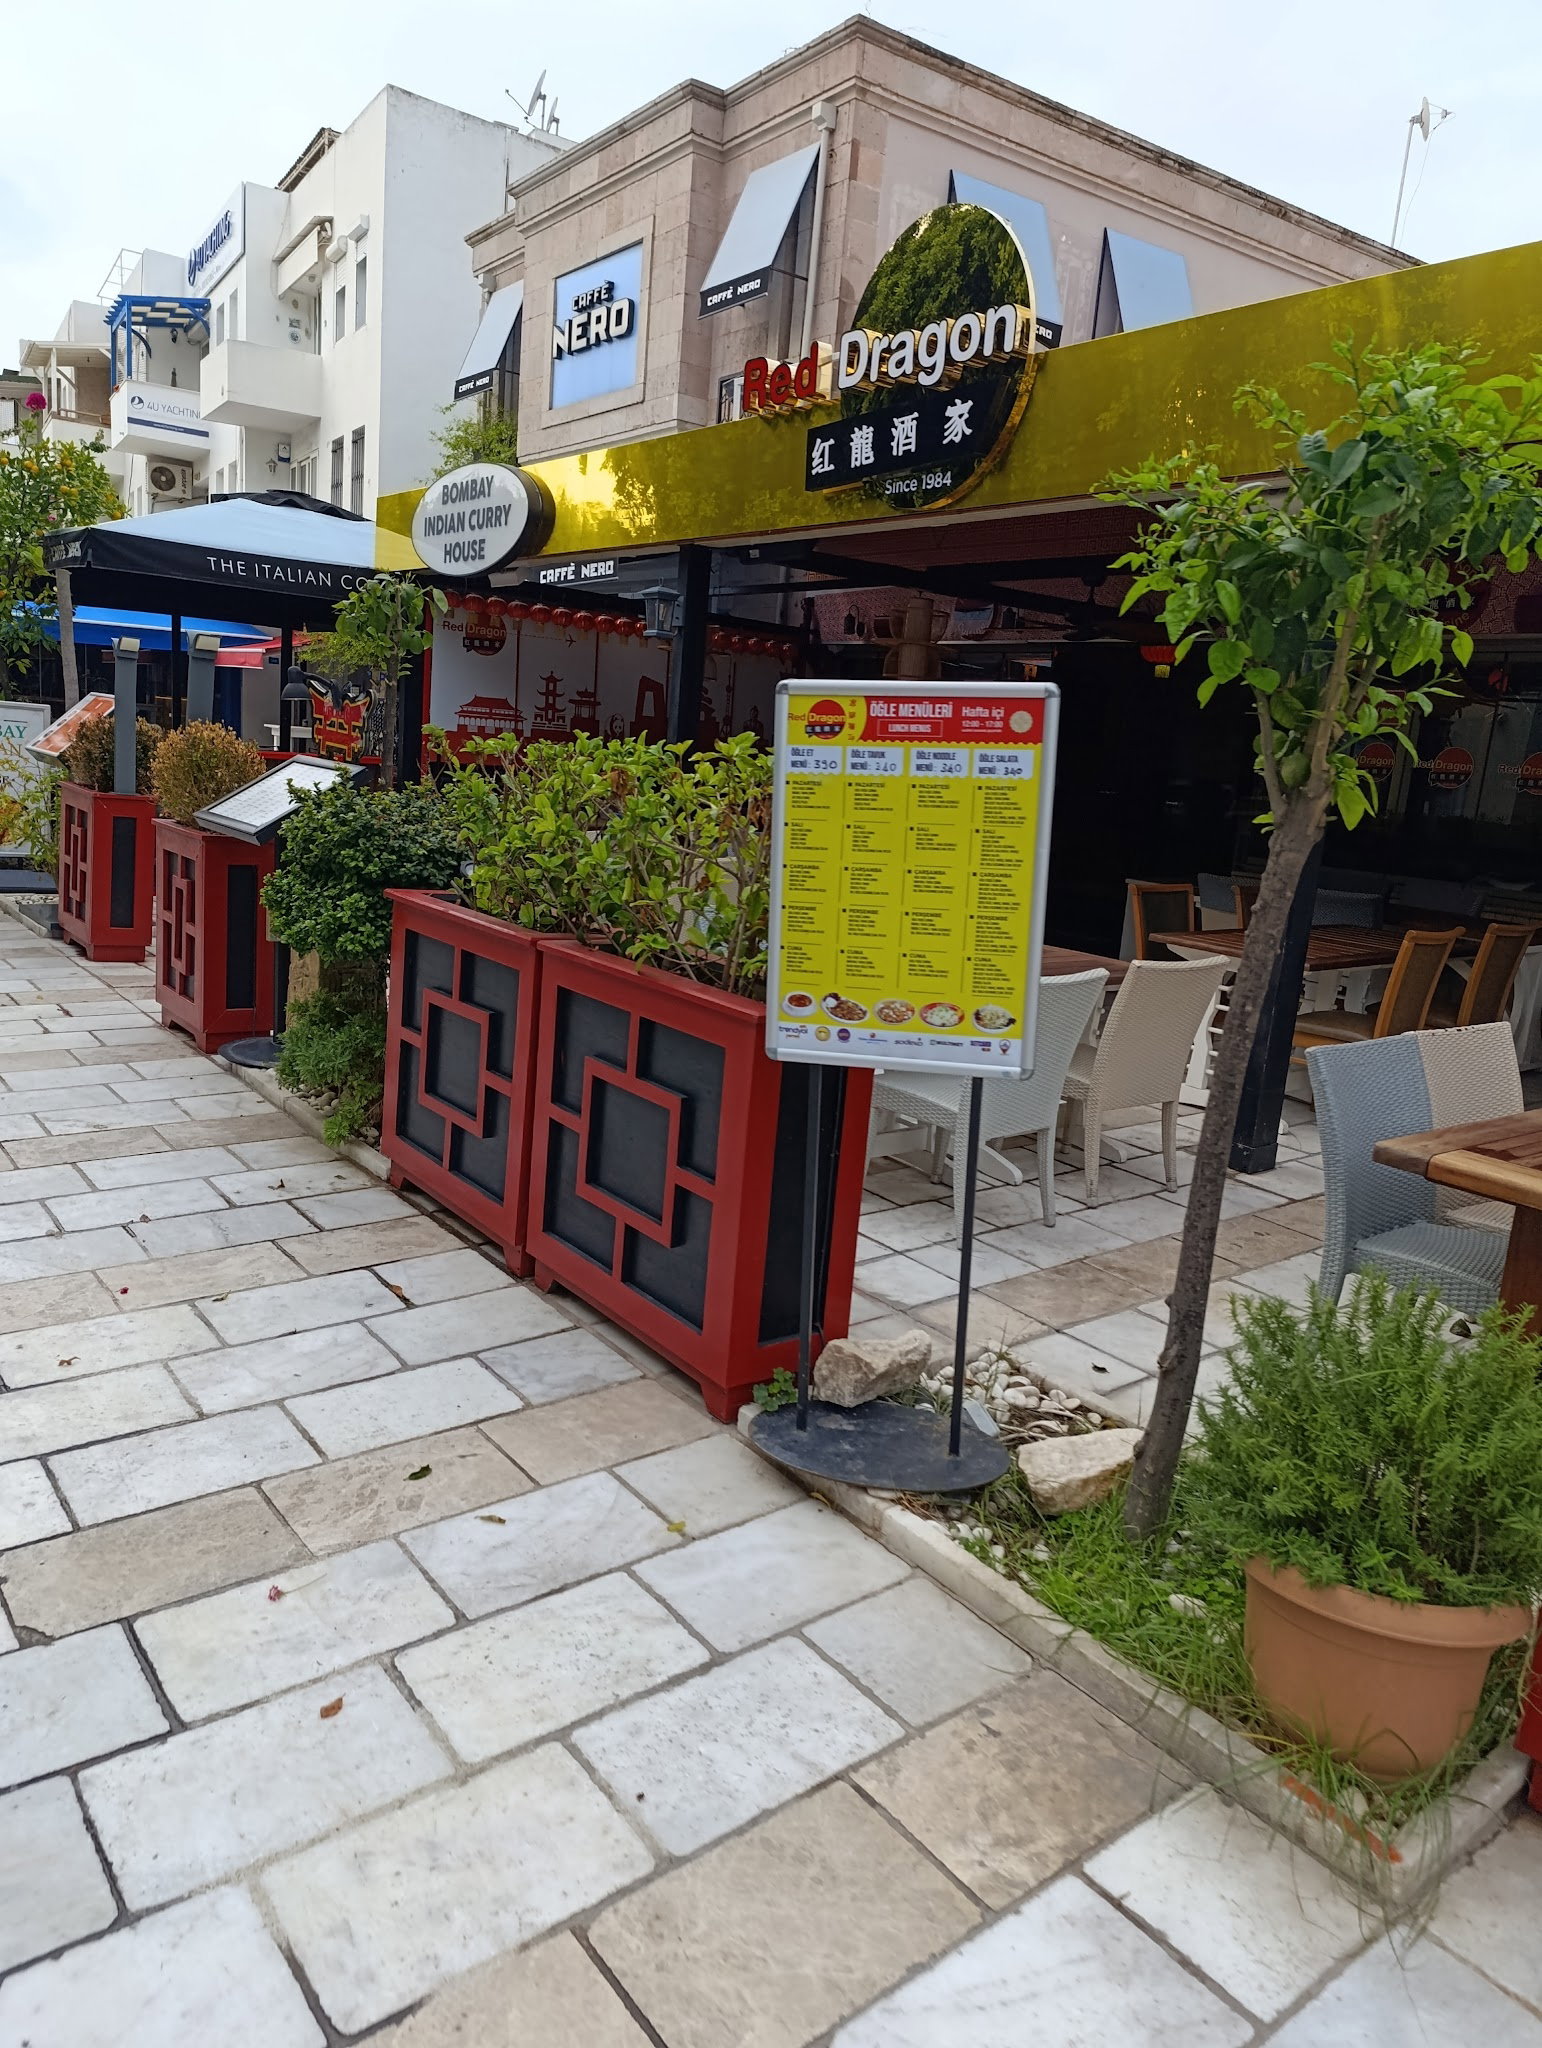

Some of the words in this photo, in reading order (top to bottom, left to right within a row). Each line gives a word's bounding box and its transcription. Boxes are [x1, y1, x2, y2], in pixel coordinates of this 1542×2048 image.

[571, 280, 613, 311] CAFFÈ
[707, 286, 733, 306] CAFFÈ
[737, 278, 761, 296] NERO
[553, 298, 631, 359] NERO
[742, 341, 821, 412] Red
[838, 303, 1017, 389] Dragon
[476, 376, 490, 386] NERO
[147, 401, 159, 412] 4U
[161, 404, 200, 419] YACHTIN
[441, 475, 495, 506] BOMBAY
[884, 476, 918, 494] Since
[921, 471, 952, 489] 1984
[424, 511, 466, 537] INDIAN
[468, 504, 512, 530] CURRY
[443, 538, 486, 564] HOUSE
[207, 556, 247, 577] THE
[254, 563, 332, 588] ITALIAN
[539, 562, 576, 584] CAFFÈ
[580, 560, 614, 578] NERO
[442, 620, 464, 632] Red
[467, 623, 507, 639] Dragon
[788, 712, 806, 721] Red
[809, 713, 846, 724] Dragon
[870, 700, 897, 717] ÖĞLE
[898, 701, 953, 718] MENÜLERİ
[961, 706, 990, 718] Hafta
[991, 707, 1005, 720] içi
[1359, 755, 1394, 767] Dragon
[1436, 760, 1473, 772] Dragon
[1498, 763, 1520, 774] Red
